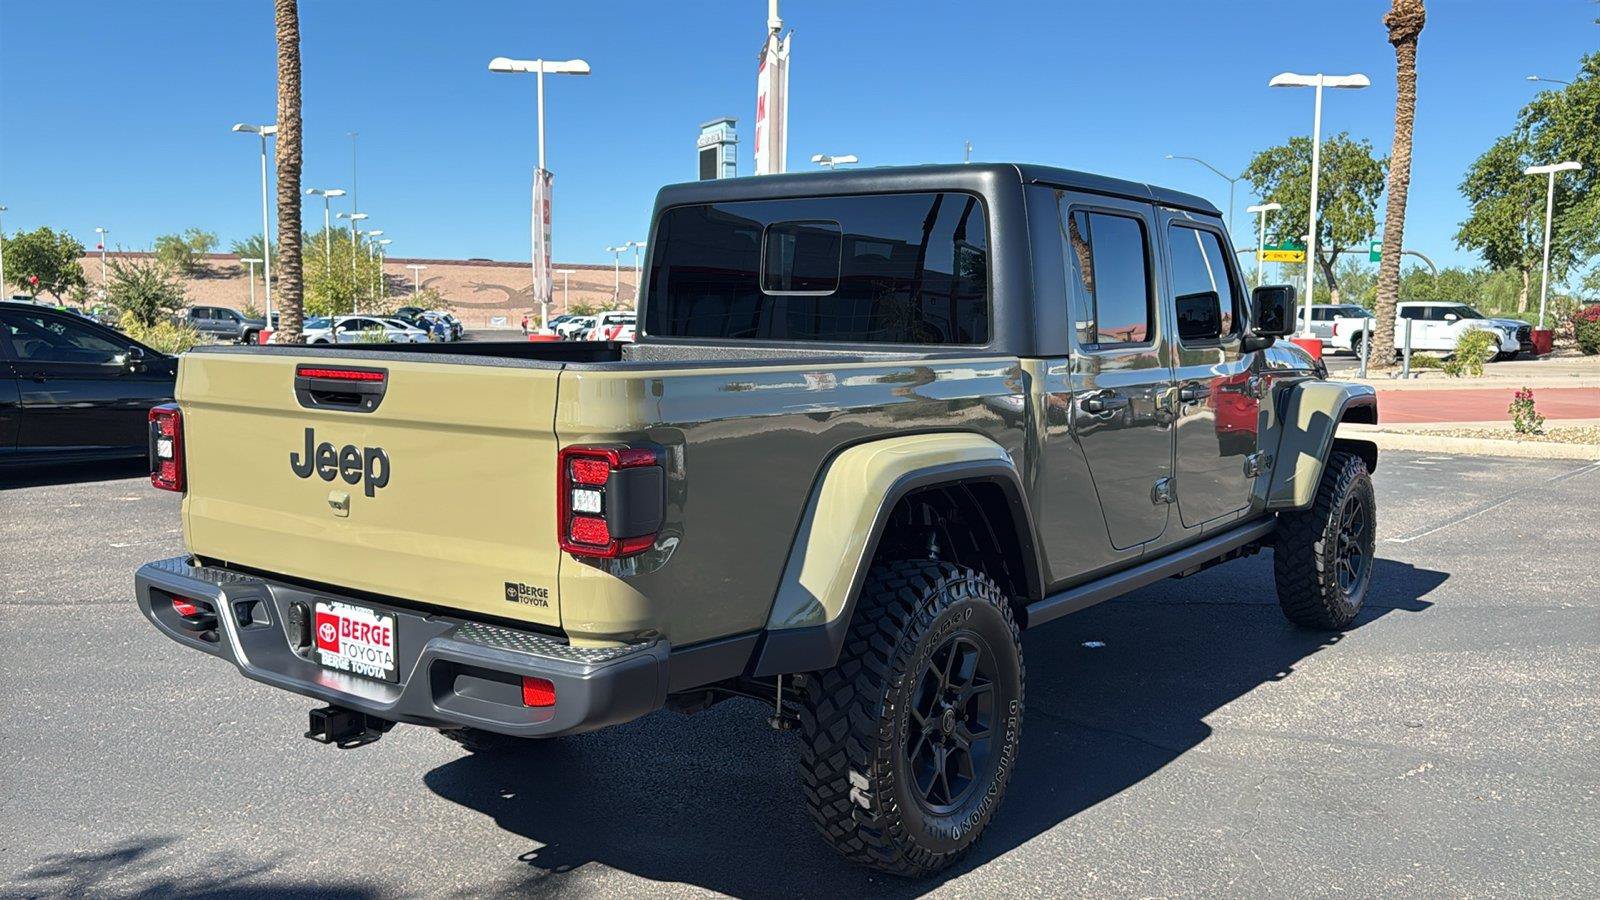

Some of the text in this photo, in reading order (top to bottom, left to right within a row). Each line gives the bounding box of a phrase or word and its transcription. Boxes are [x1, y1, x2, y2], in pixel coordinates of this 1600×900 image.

[290, 428, 390, 498] Jeep
[519, 583, 548, 598] BERGE
[520, 596, 548, 608] TOYOTA
[342, 617, 391, 647] BERGE
[321, 653, 386, 679] BERGE TOYOTA
[342, 642, 392, 664] TOYOTA
[963, 700, 1018, 834] DESTINATION
